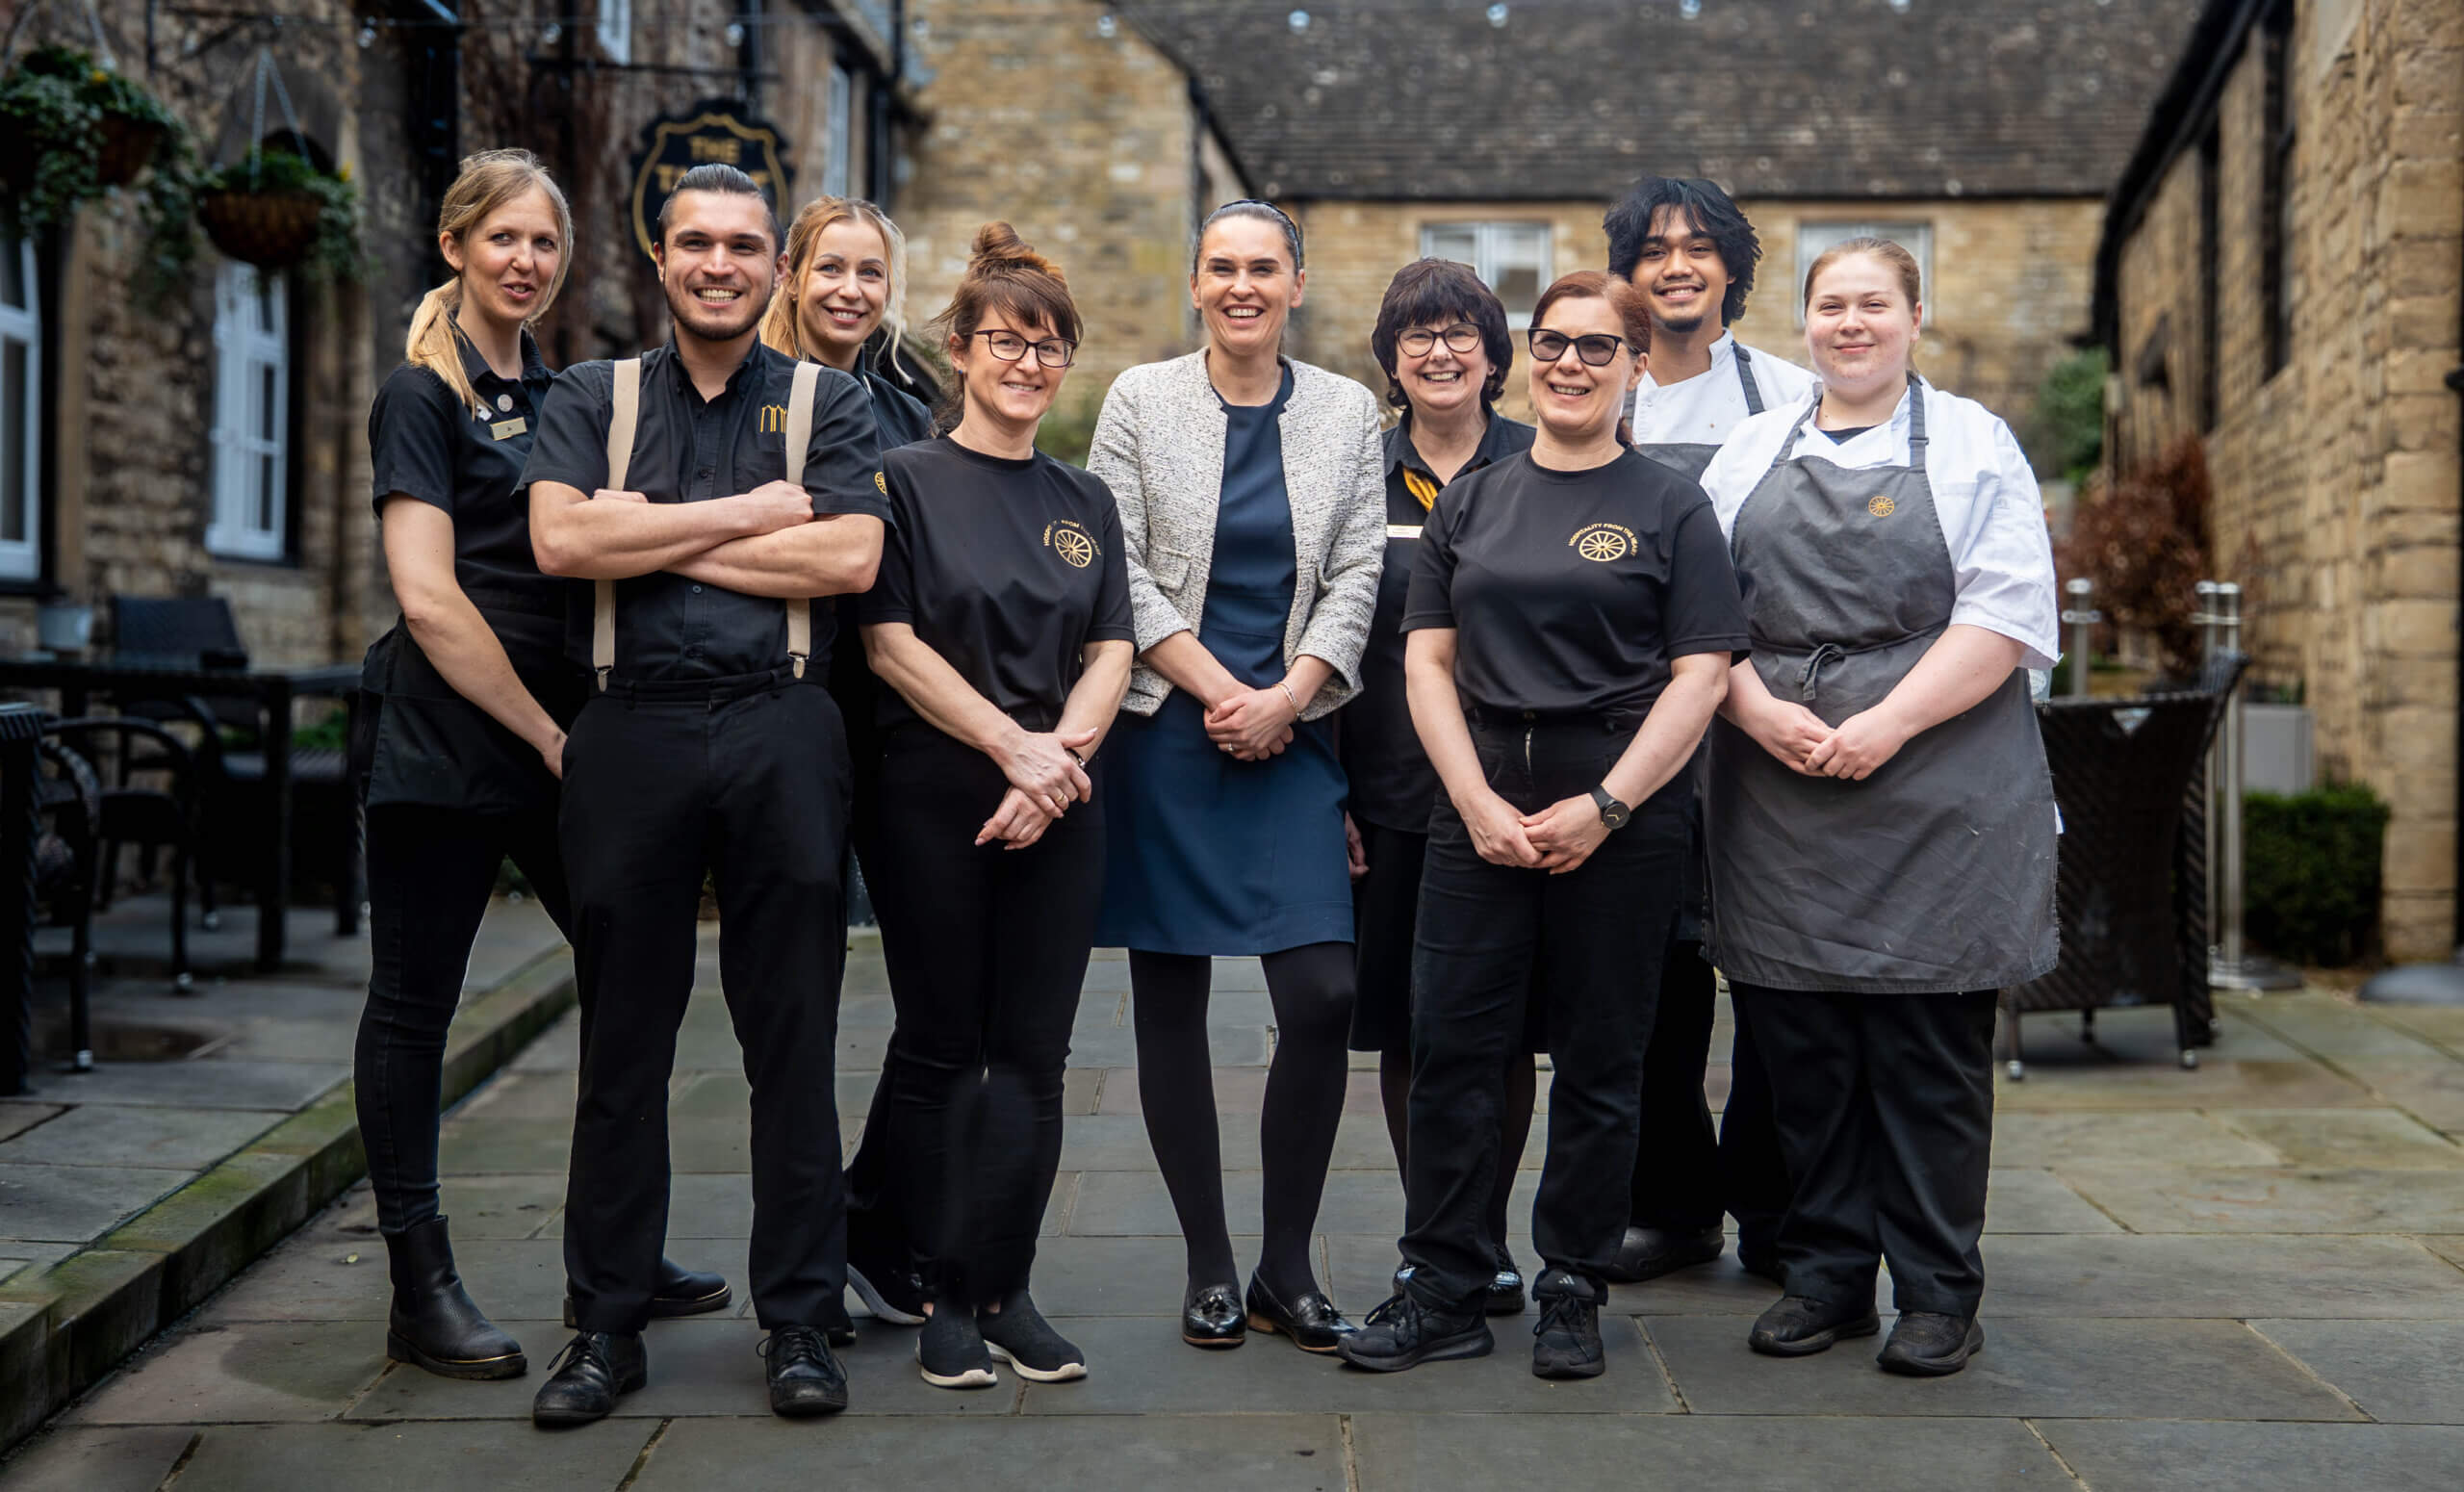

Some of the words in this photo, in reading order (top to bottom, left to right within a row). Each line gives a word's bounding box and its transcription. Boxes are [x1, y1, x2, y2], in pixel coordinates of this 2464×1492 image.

[688, 136, 741, 163] THE
[1568, 523, 1603, 546] HOSPITALITY
[1603, 523, 1624, 531] FROM
[1623, 527, 1634, 538] THE
